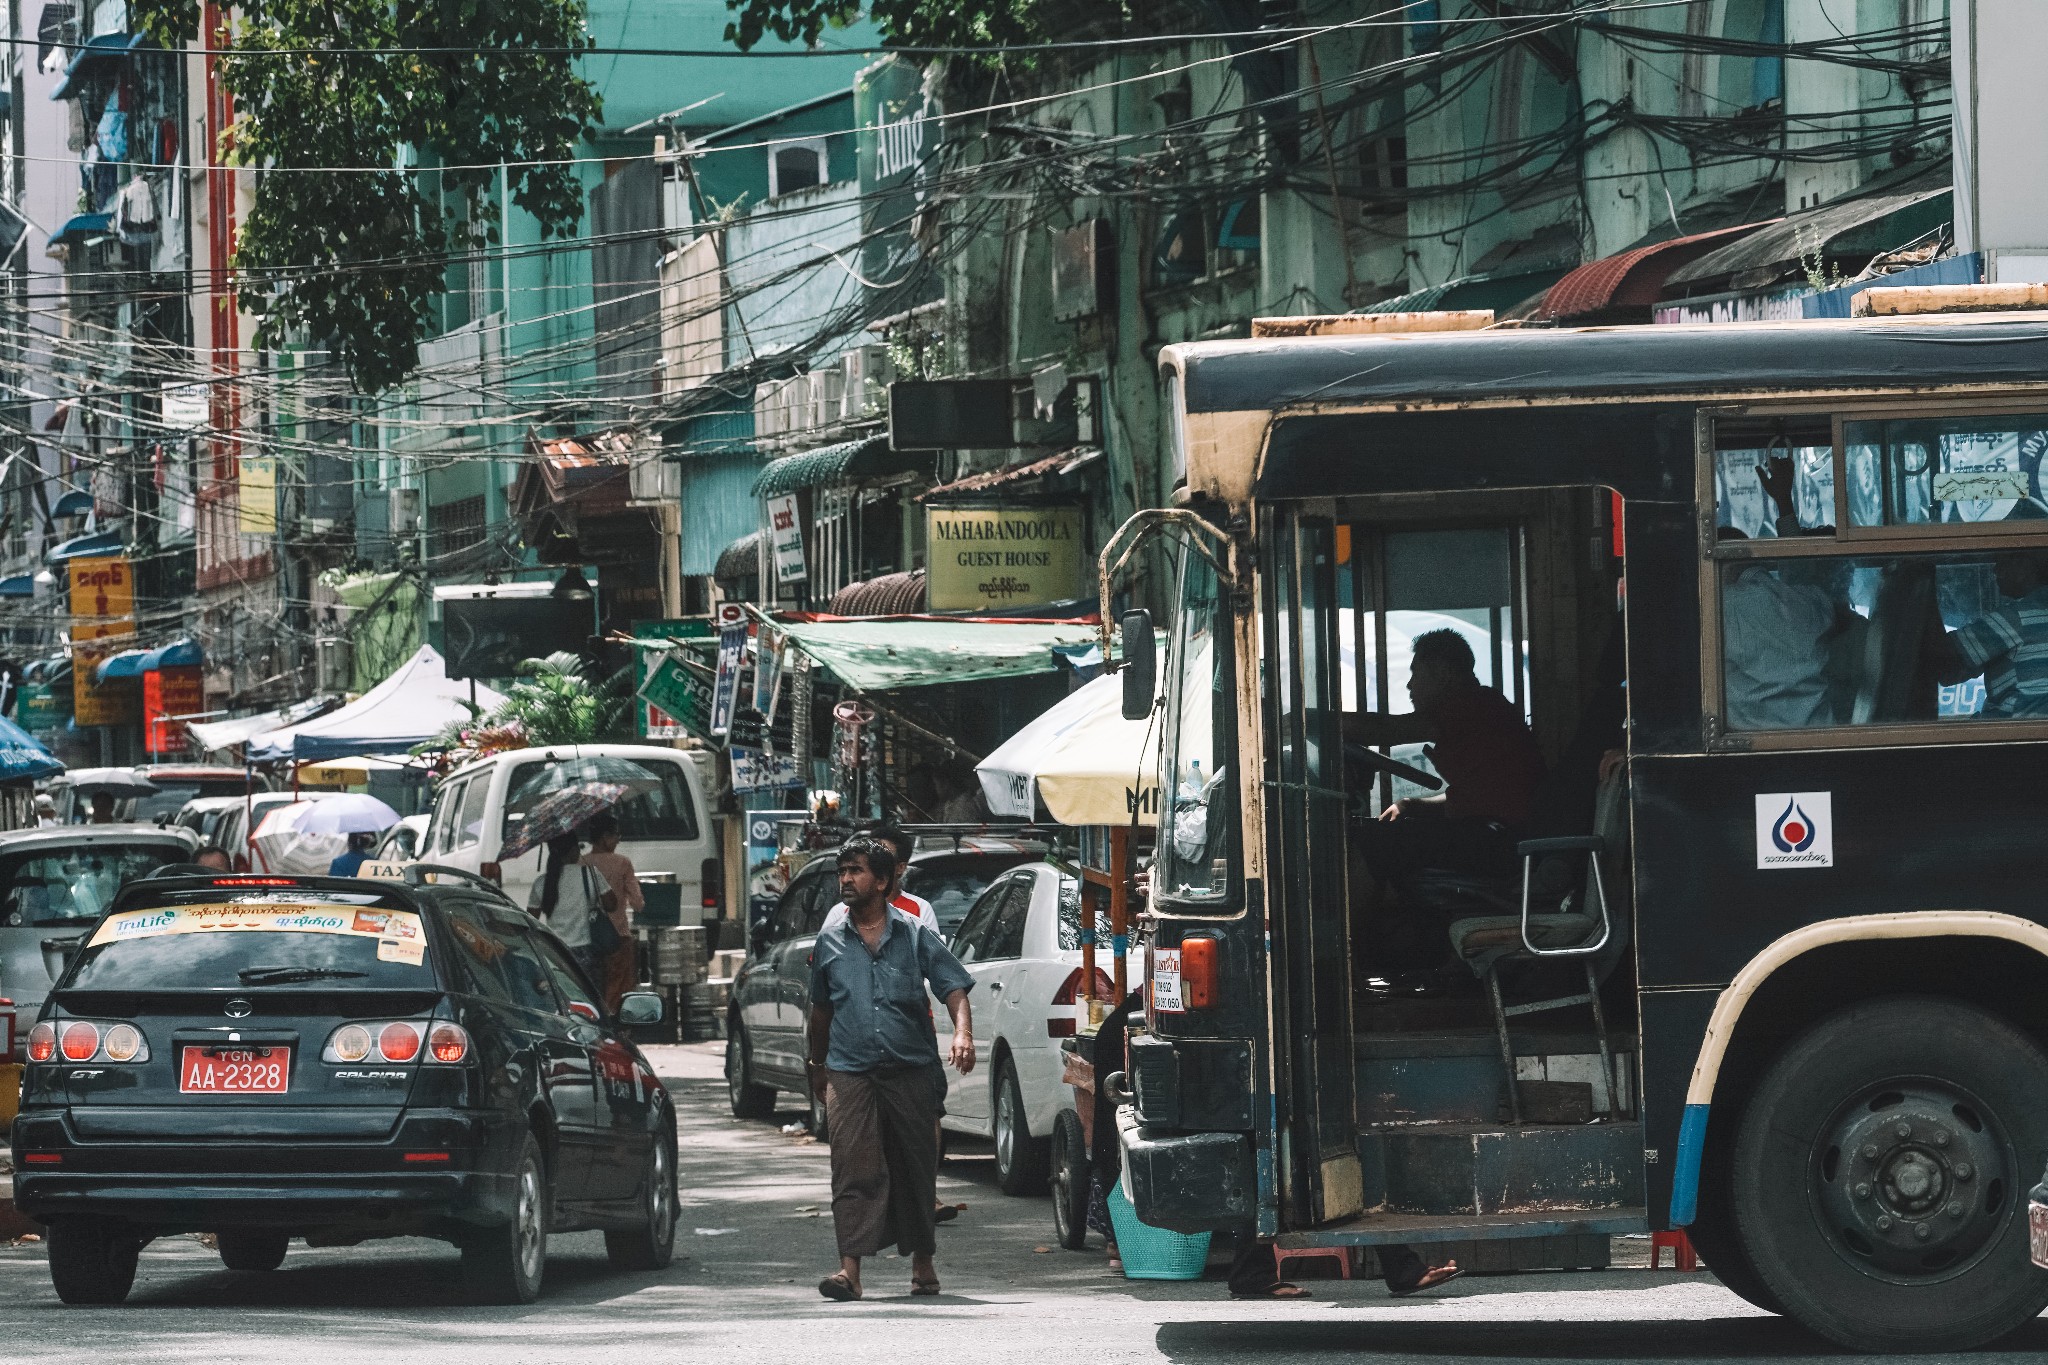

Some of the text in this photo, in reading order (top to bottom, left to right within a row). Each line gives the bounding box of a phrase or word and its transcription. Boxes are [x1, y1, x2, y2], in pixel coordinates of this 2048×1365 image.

[875, 102, 927, 201] Aung
[936, 519, 1071, 541] MAHABANDOOLA
[957, 551, 1051, 567] GUEST HOUSE
[116, 915, 172, 931] TruLife
[220, 1050, 253, 1062] YGN
[187, 1063, 280, 1089] AA-2328
